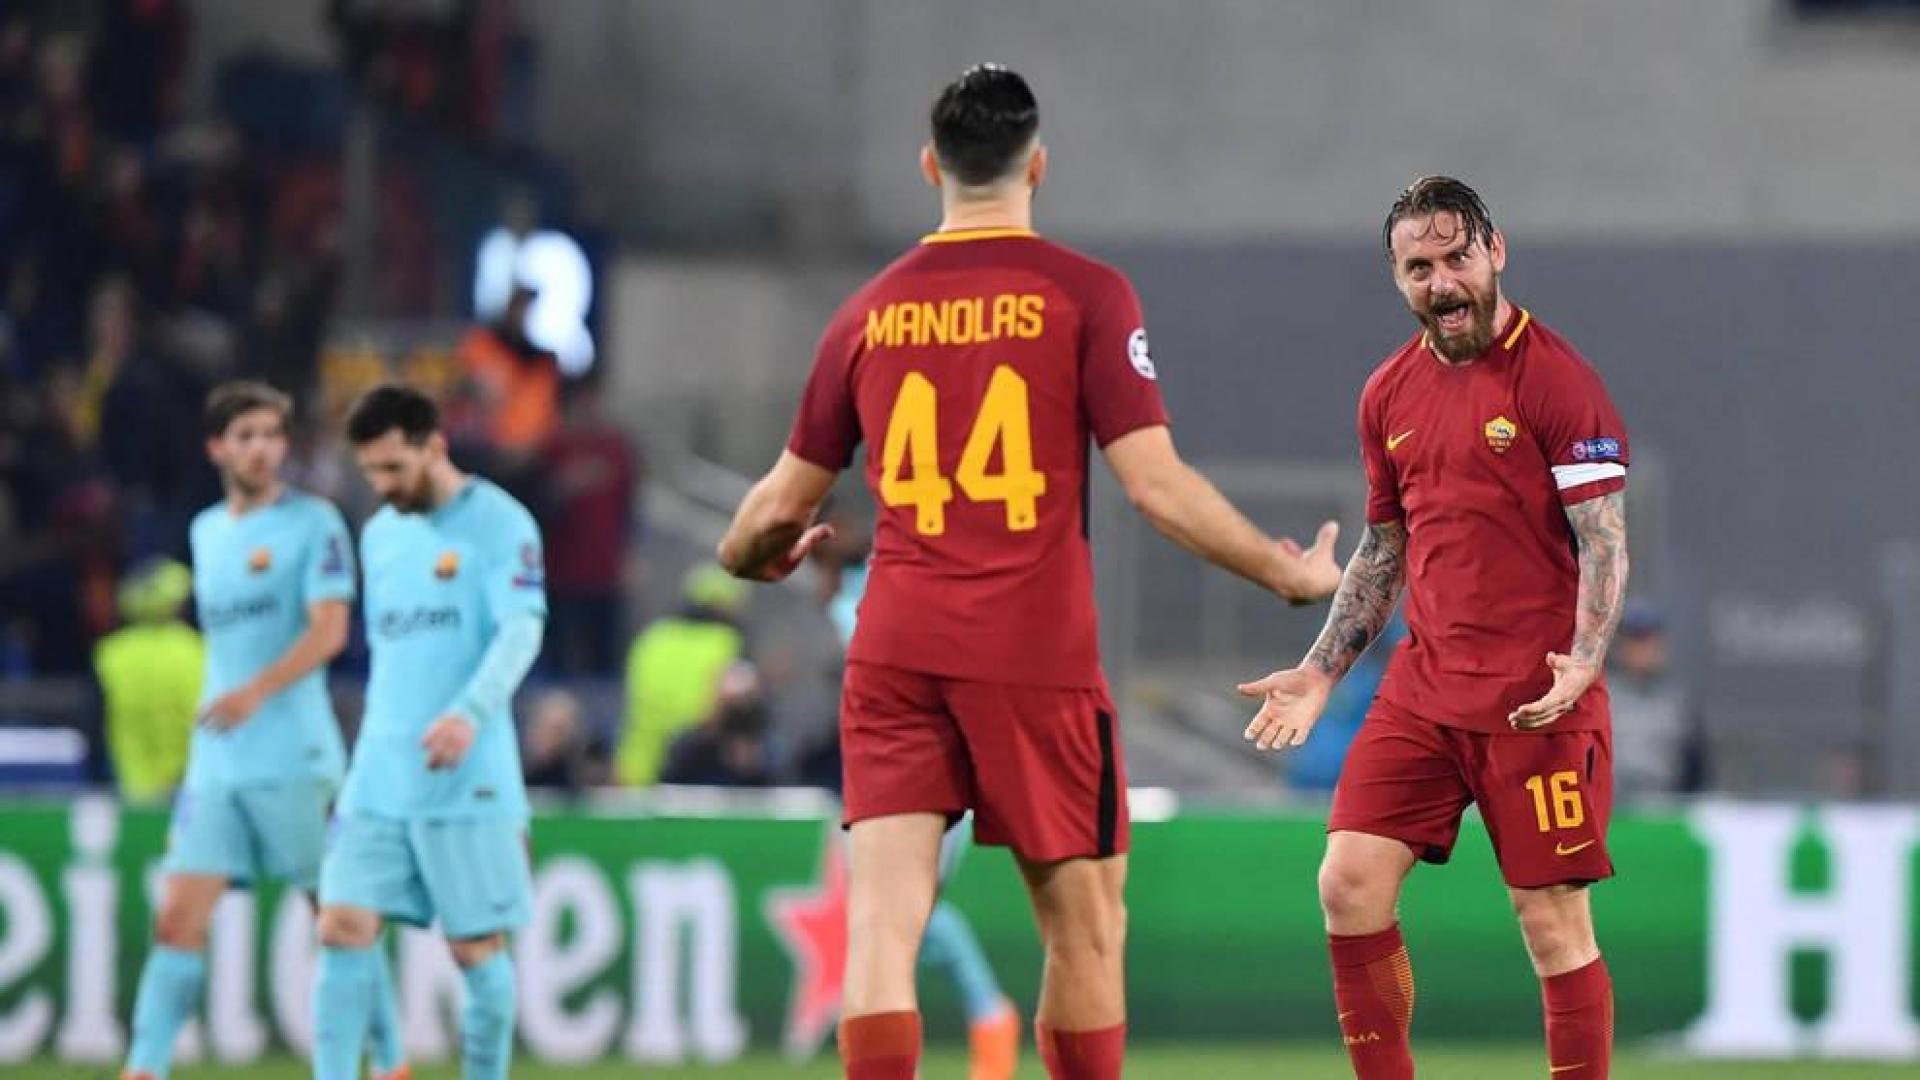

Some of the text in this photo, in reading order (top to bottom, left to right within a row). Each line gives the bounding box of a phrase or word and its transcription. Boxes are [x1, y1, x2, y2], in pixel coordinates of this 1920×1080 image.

[867, 294, 1045, 350] MANOLAS
[880, 364, 1046, 536] 44
[1525, 771, 1585, 833] 16
